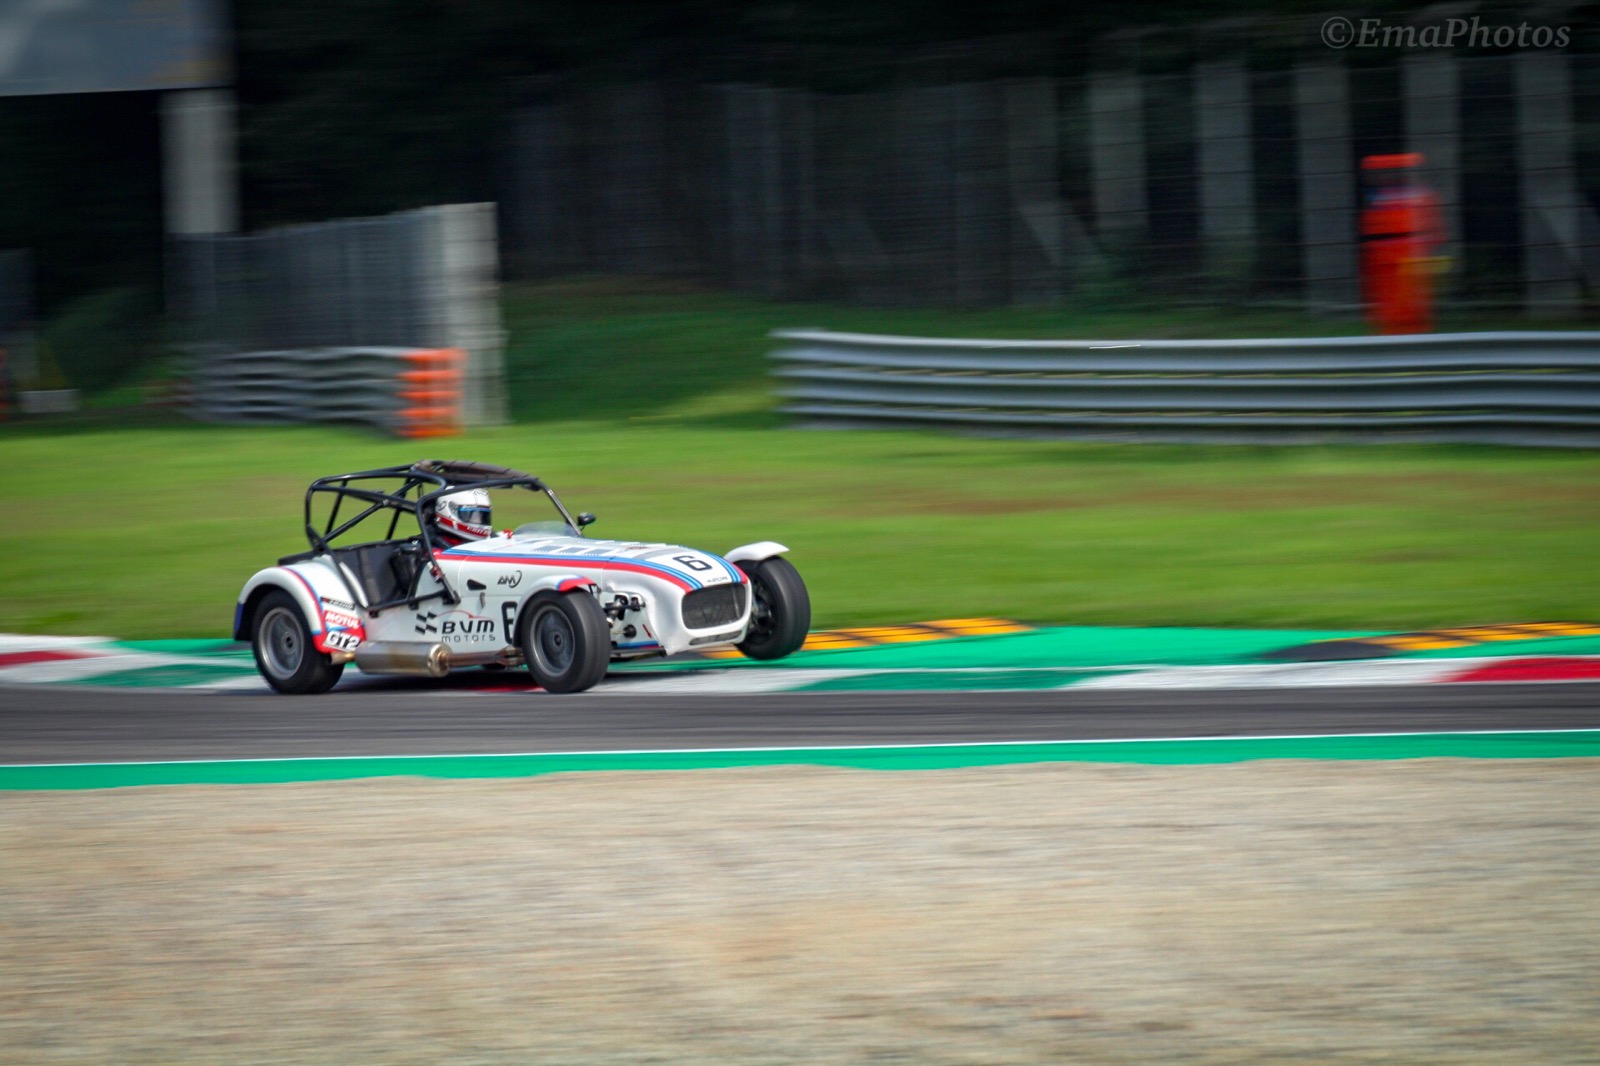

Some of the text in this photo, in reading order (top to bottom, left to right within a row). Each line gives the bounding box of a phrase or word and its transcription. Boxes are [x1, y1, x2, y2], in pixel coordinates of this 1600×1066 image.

[673, 555, 712, 571] 6
[325, 612, 360, 629] MOTUL
[324, 630, 360, 652] GT2
